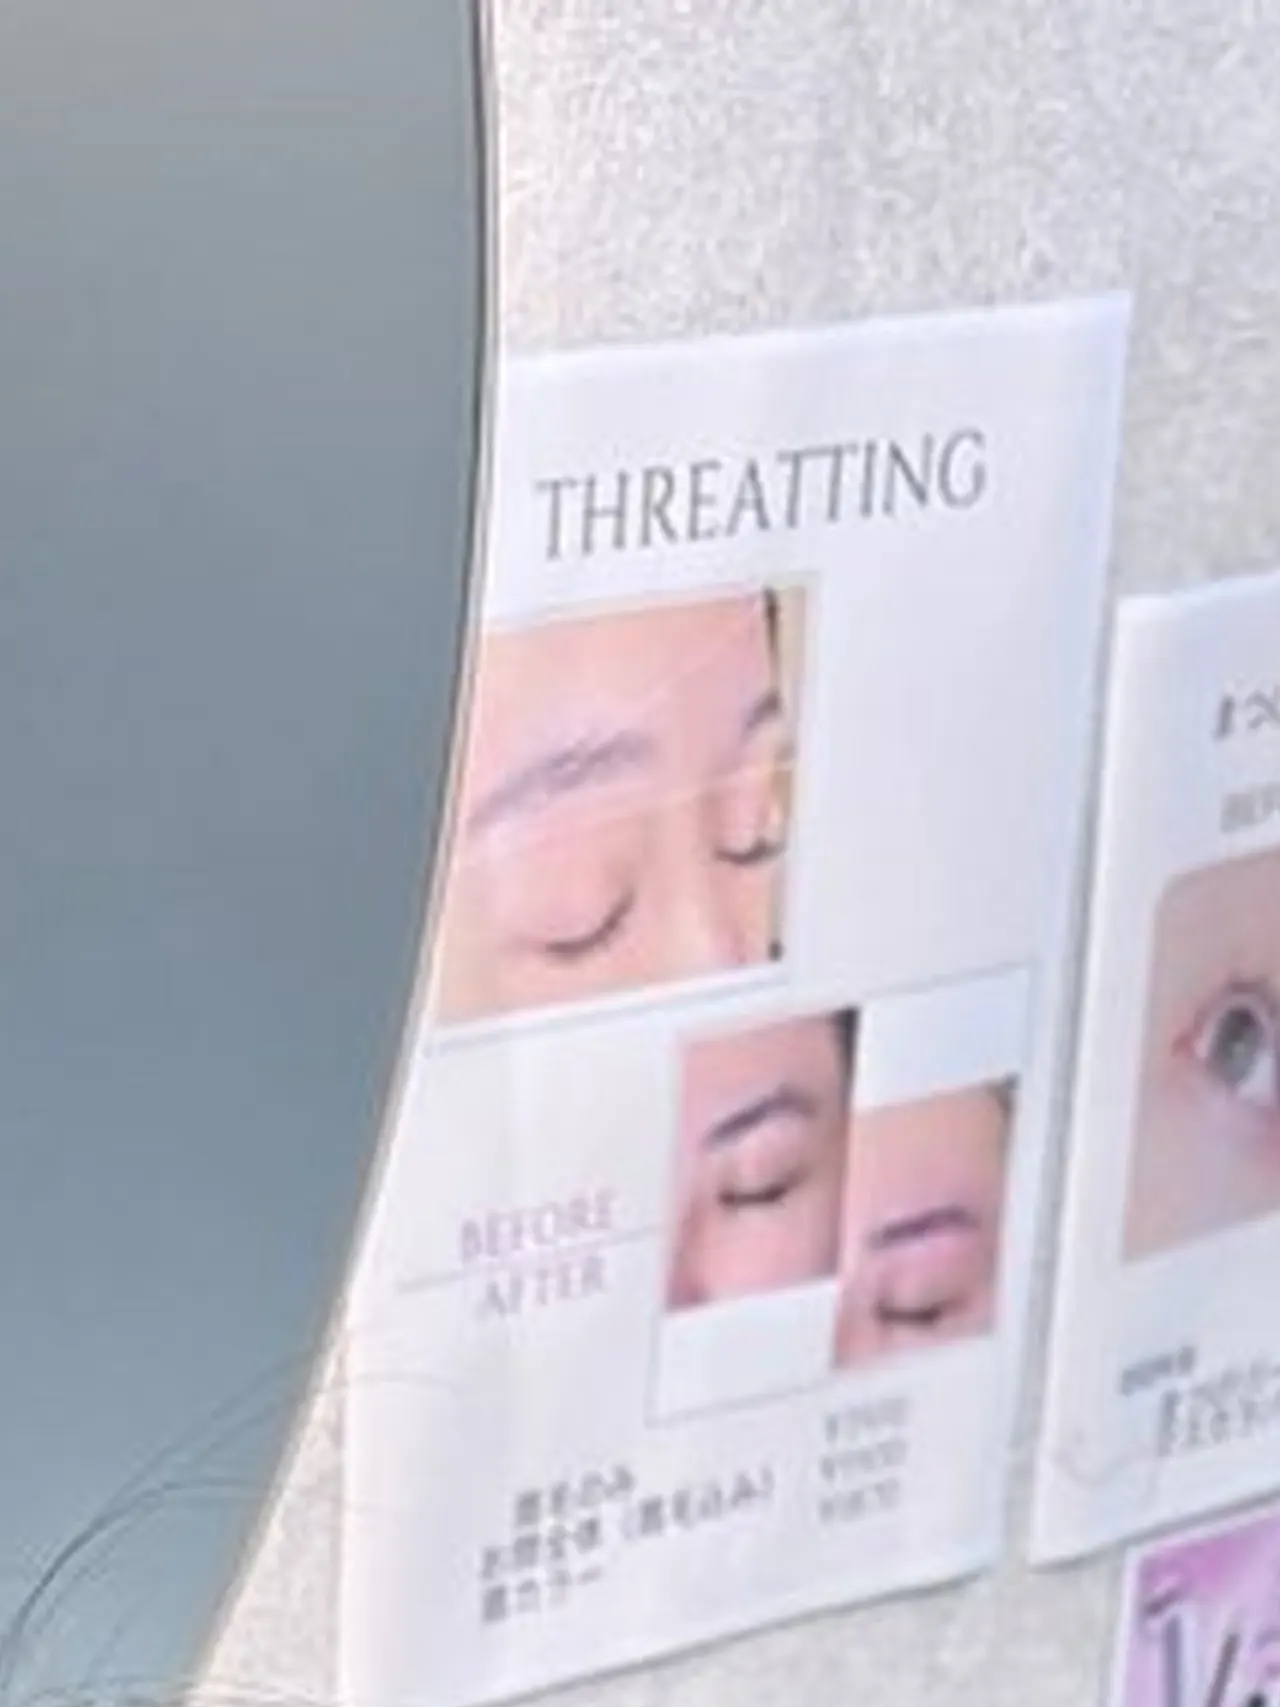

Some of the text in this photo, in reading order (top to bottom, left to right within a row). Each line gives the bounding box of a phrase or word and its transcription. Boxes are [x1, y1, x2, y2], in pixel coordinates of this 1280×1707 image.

[534, 429, 987, 559] THREATTING
[460, 1191, 614, 1256] BEFORE
[482, 1258, 606, 1317] AFTER
